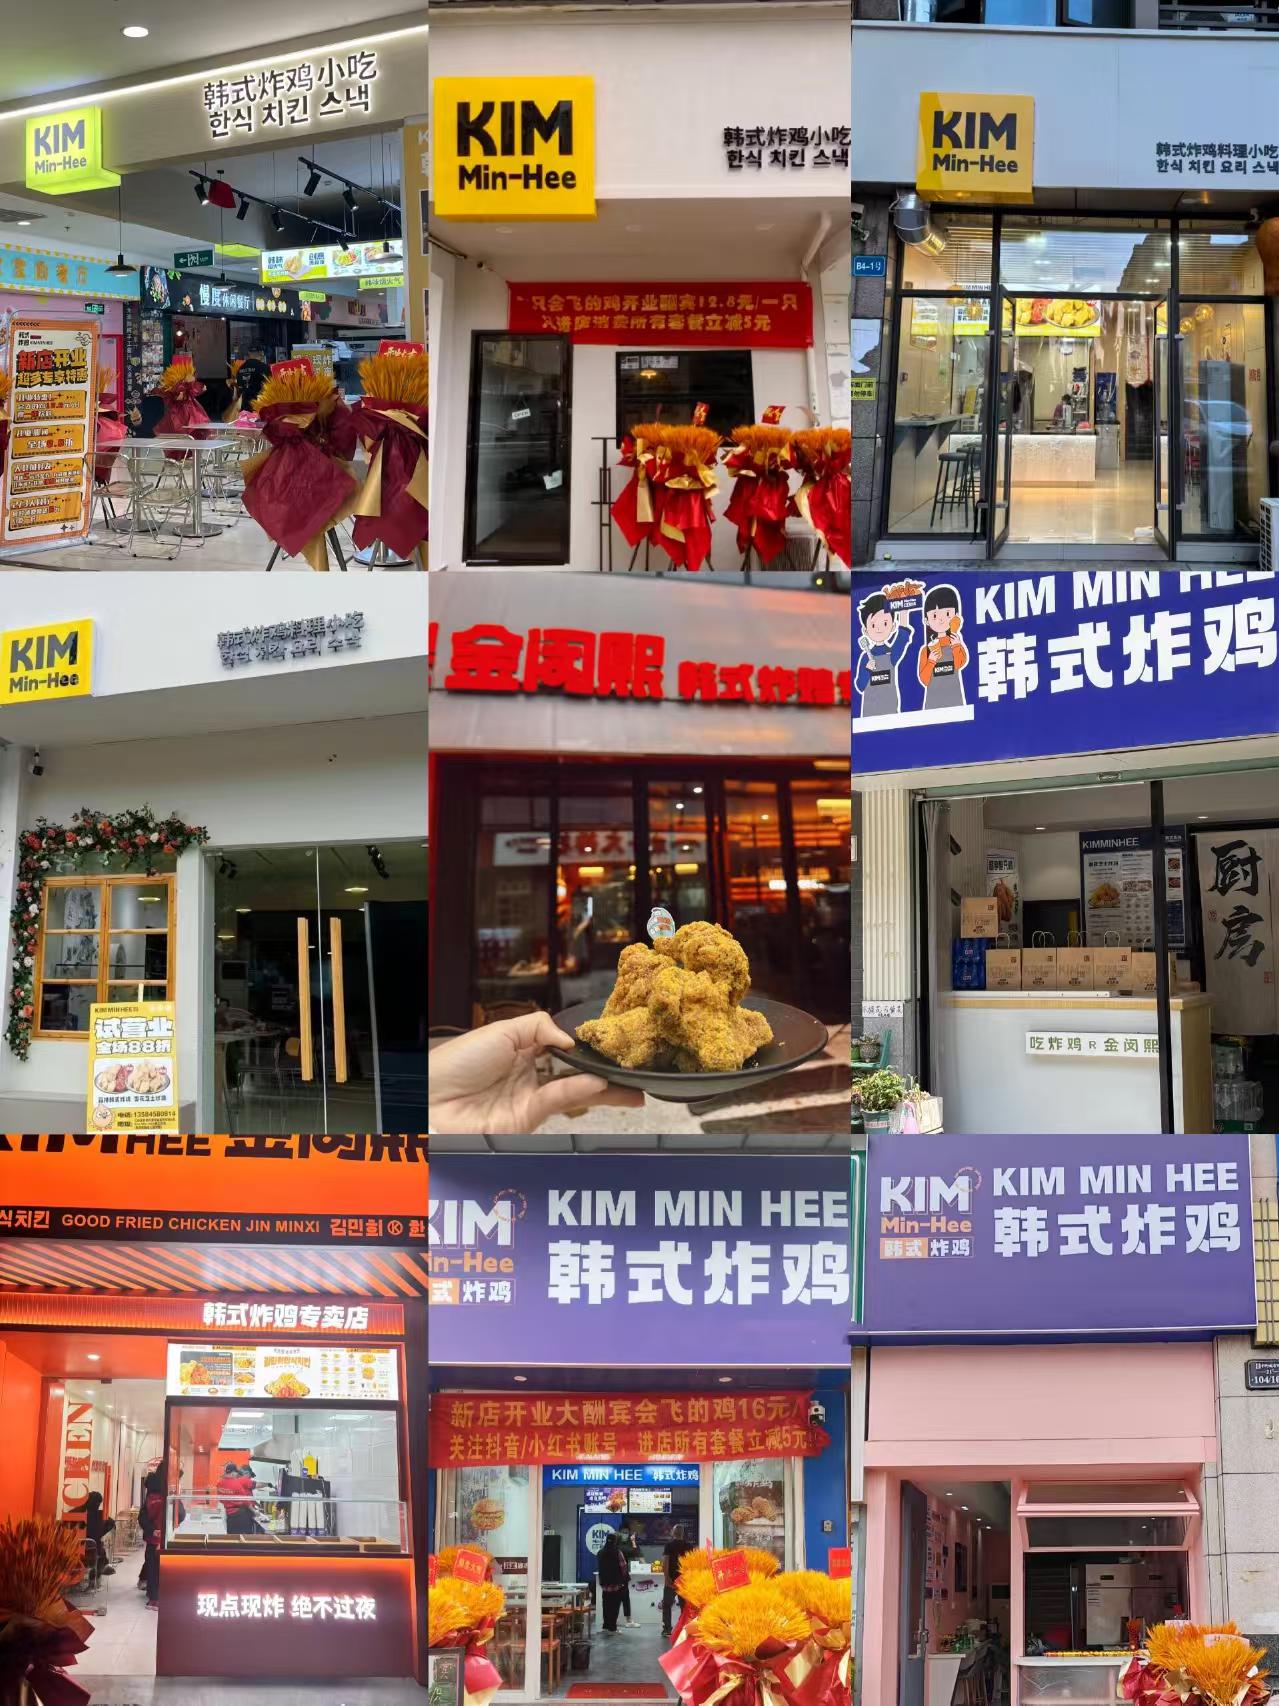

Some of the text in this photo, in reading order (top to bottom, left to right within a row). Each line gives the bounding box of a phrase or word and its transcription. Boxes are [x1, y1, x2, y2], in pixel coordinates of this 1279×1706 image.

[204, 50, 377, 109] 韩式炸鸡小吃
[209, 83, 371, 138] 한식 치킨 스낵
[34, 119, 84, 157] KIM
[457, 100, 573, 157] KIM
[723, 125, 851, 147] 韩式炸鸡小吃
[932, 110, 1017, 150] KIM
[727, 148, 849, 169] 한식 치킨 스낵
[932, 153, 1018, 173] Min-Hee
[1155, 141, 1279, 159] 韩式炸鸡料理小吃
[34, 155, 87, 175] Min-Hee
[458, 163, 577, 191] Min-Hee
[1156, 159, 1183, 173] 한식
[1188, 159, 1216, 174] 치킨
[1220, 160, 1247, 175] 요리
[17, 347, 87, 371] 新店开业
[975, 575, 1056, 625] KIM
[1073, 571, 1160, 609] MIN
[10, 630, 78, 673] KIM
[445, 624, 665, 698] 金闵熙
[977, 597, 1278, 703] 韩式炸鸡
[9, 672, 79, 694] Min-Hee
[1207, 839, 1265, 967] 厨房
[95, 1016, 174, 1039] 试营业
[1030, 1036, 1159, 1054] 吃炸鸡 R 金闵熙
[993, 1162, 1239, 1196] KIM MIN HEE
[880, 1176, 970, 1213] KIM
[548, 1190, 848, 1228] KIM MIN HEE
[62, 1214, 110, 1227] GOOD
[116, 1216, 164, 1229] FRIED
[168, 1217, 241, 1232] CHICKEN
[246, 1220, 270, 1232] JIN
[276, 1220, 320, 1233] MINXI
[330, 1218, 383, 1237] 김민희
[880, 1216, 972, 1234] Min-Hee
[993, 1201, 1241, 1258] 韩式炸鸡
[547, 1239, 849, 1305] 韩式炸鸡
[203, 1302, 368, 1330] 韩式炸鸡专卖店
[552, 1469, 699, 1481] KIM MIN HEE 韩式炸鸡
[197, 1593, 376, 1620] 现点现炸 绝不过夜
